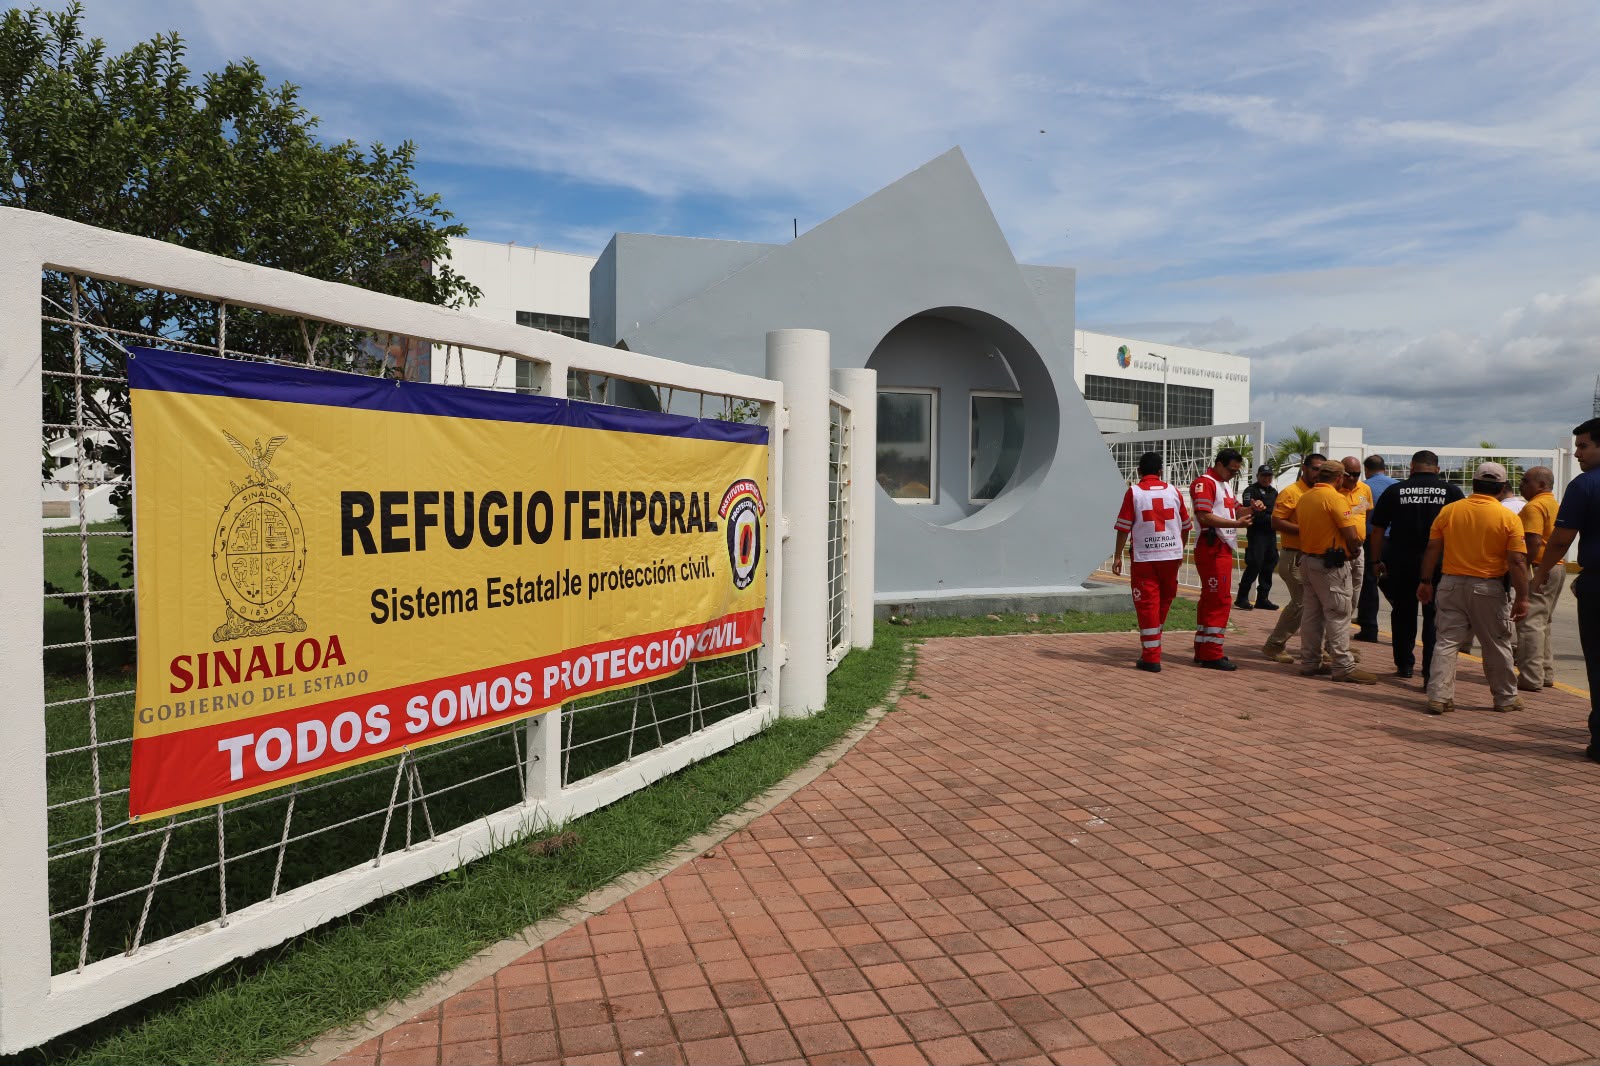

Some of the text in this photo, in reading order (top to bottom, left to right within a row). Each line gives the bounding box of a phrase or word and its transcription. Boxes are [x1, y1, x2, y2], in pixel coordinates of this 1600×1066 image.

[242, 490, 282, 504] SINALOA
[720, 483, 745, 514] INSTITUTO
[1399, 487, 1447, 495] BOMBEROS
[1400, 496, 1446, 504] MAZATLAN
[340, 490, 718, 556] REFUGIO TEMPORAL
[250, 606, 274, 616] 1831
[370, 585, 478, 625] Sistema
[486, 571, 561, 609] Estatal
[588, 558, 676, 600] protección
[680, 555, 715, 582] civil.
[169, 634, 347, 694] SINALOA
[138, 669, 369, 724] GOBIERNO DEL ESTADO
[217, 704, 391, 782] TODOS
[405, 671, 533, 735] SOMOS
[542, 629, 698, 700] PROTECCIÓN
